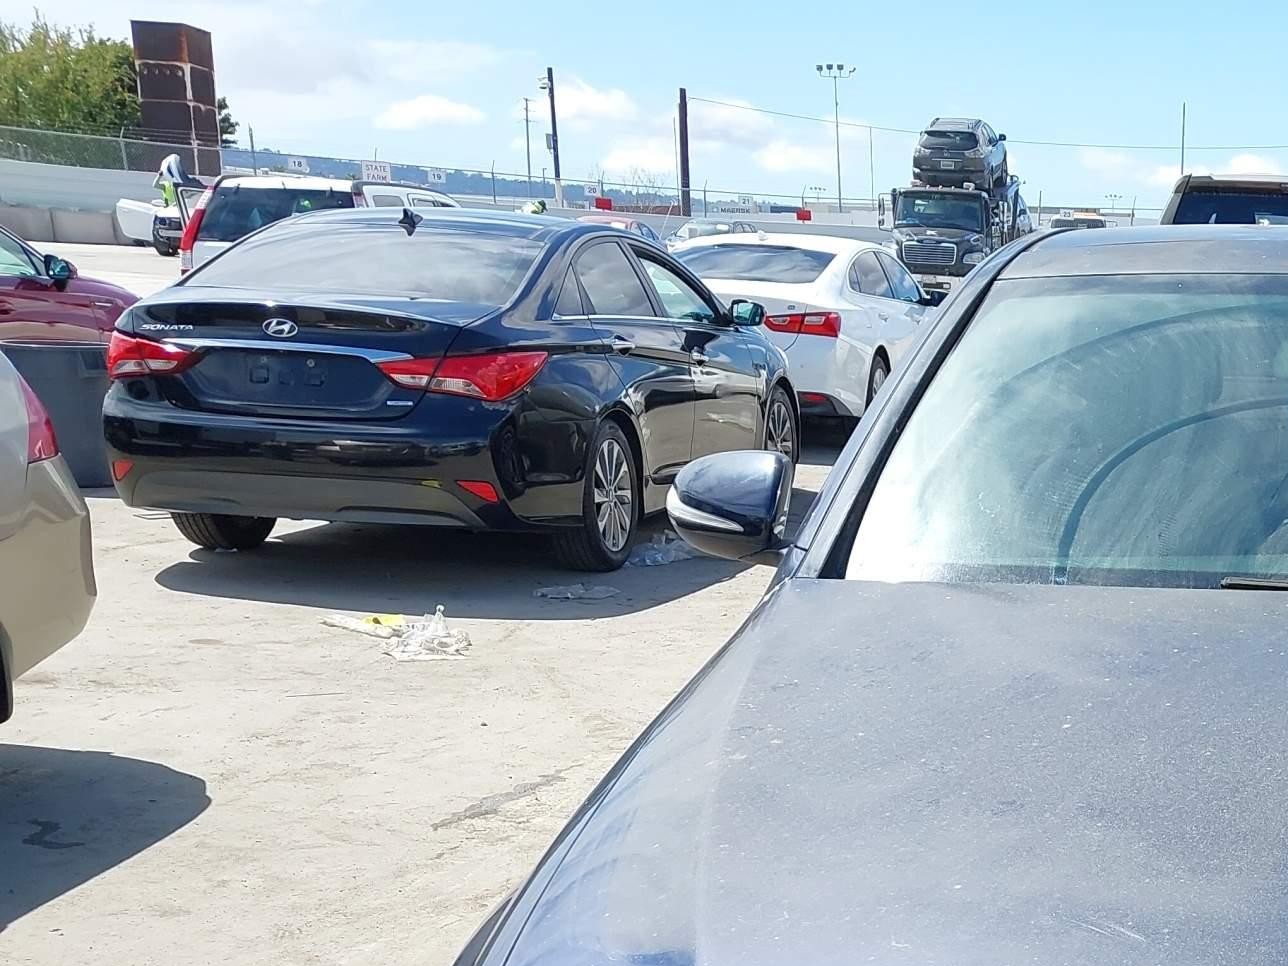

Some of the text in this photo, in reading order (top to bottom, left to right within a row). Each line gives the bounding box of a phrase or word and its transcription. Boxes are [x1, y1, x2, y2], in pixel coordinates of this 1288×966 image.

[365, 164, 388, 173] STATE
[366, 173, 388, 182] FARM
[432, 173, 442, 181] 19
[587, 186, 598, 194] 20
[139, 323, 194, 331] SONATA
